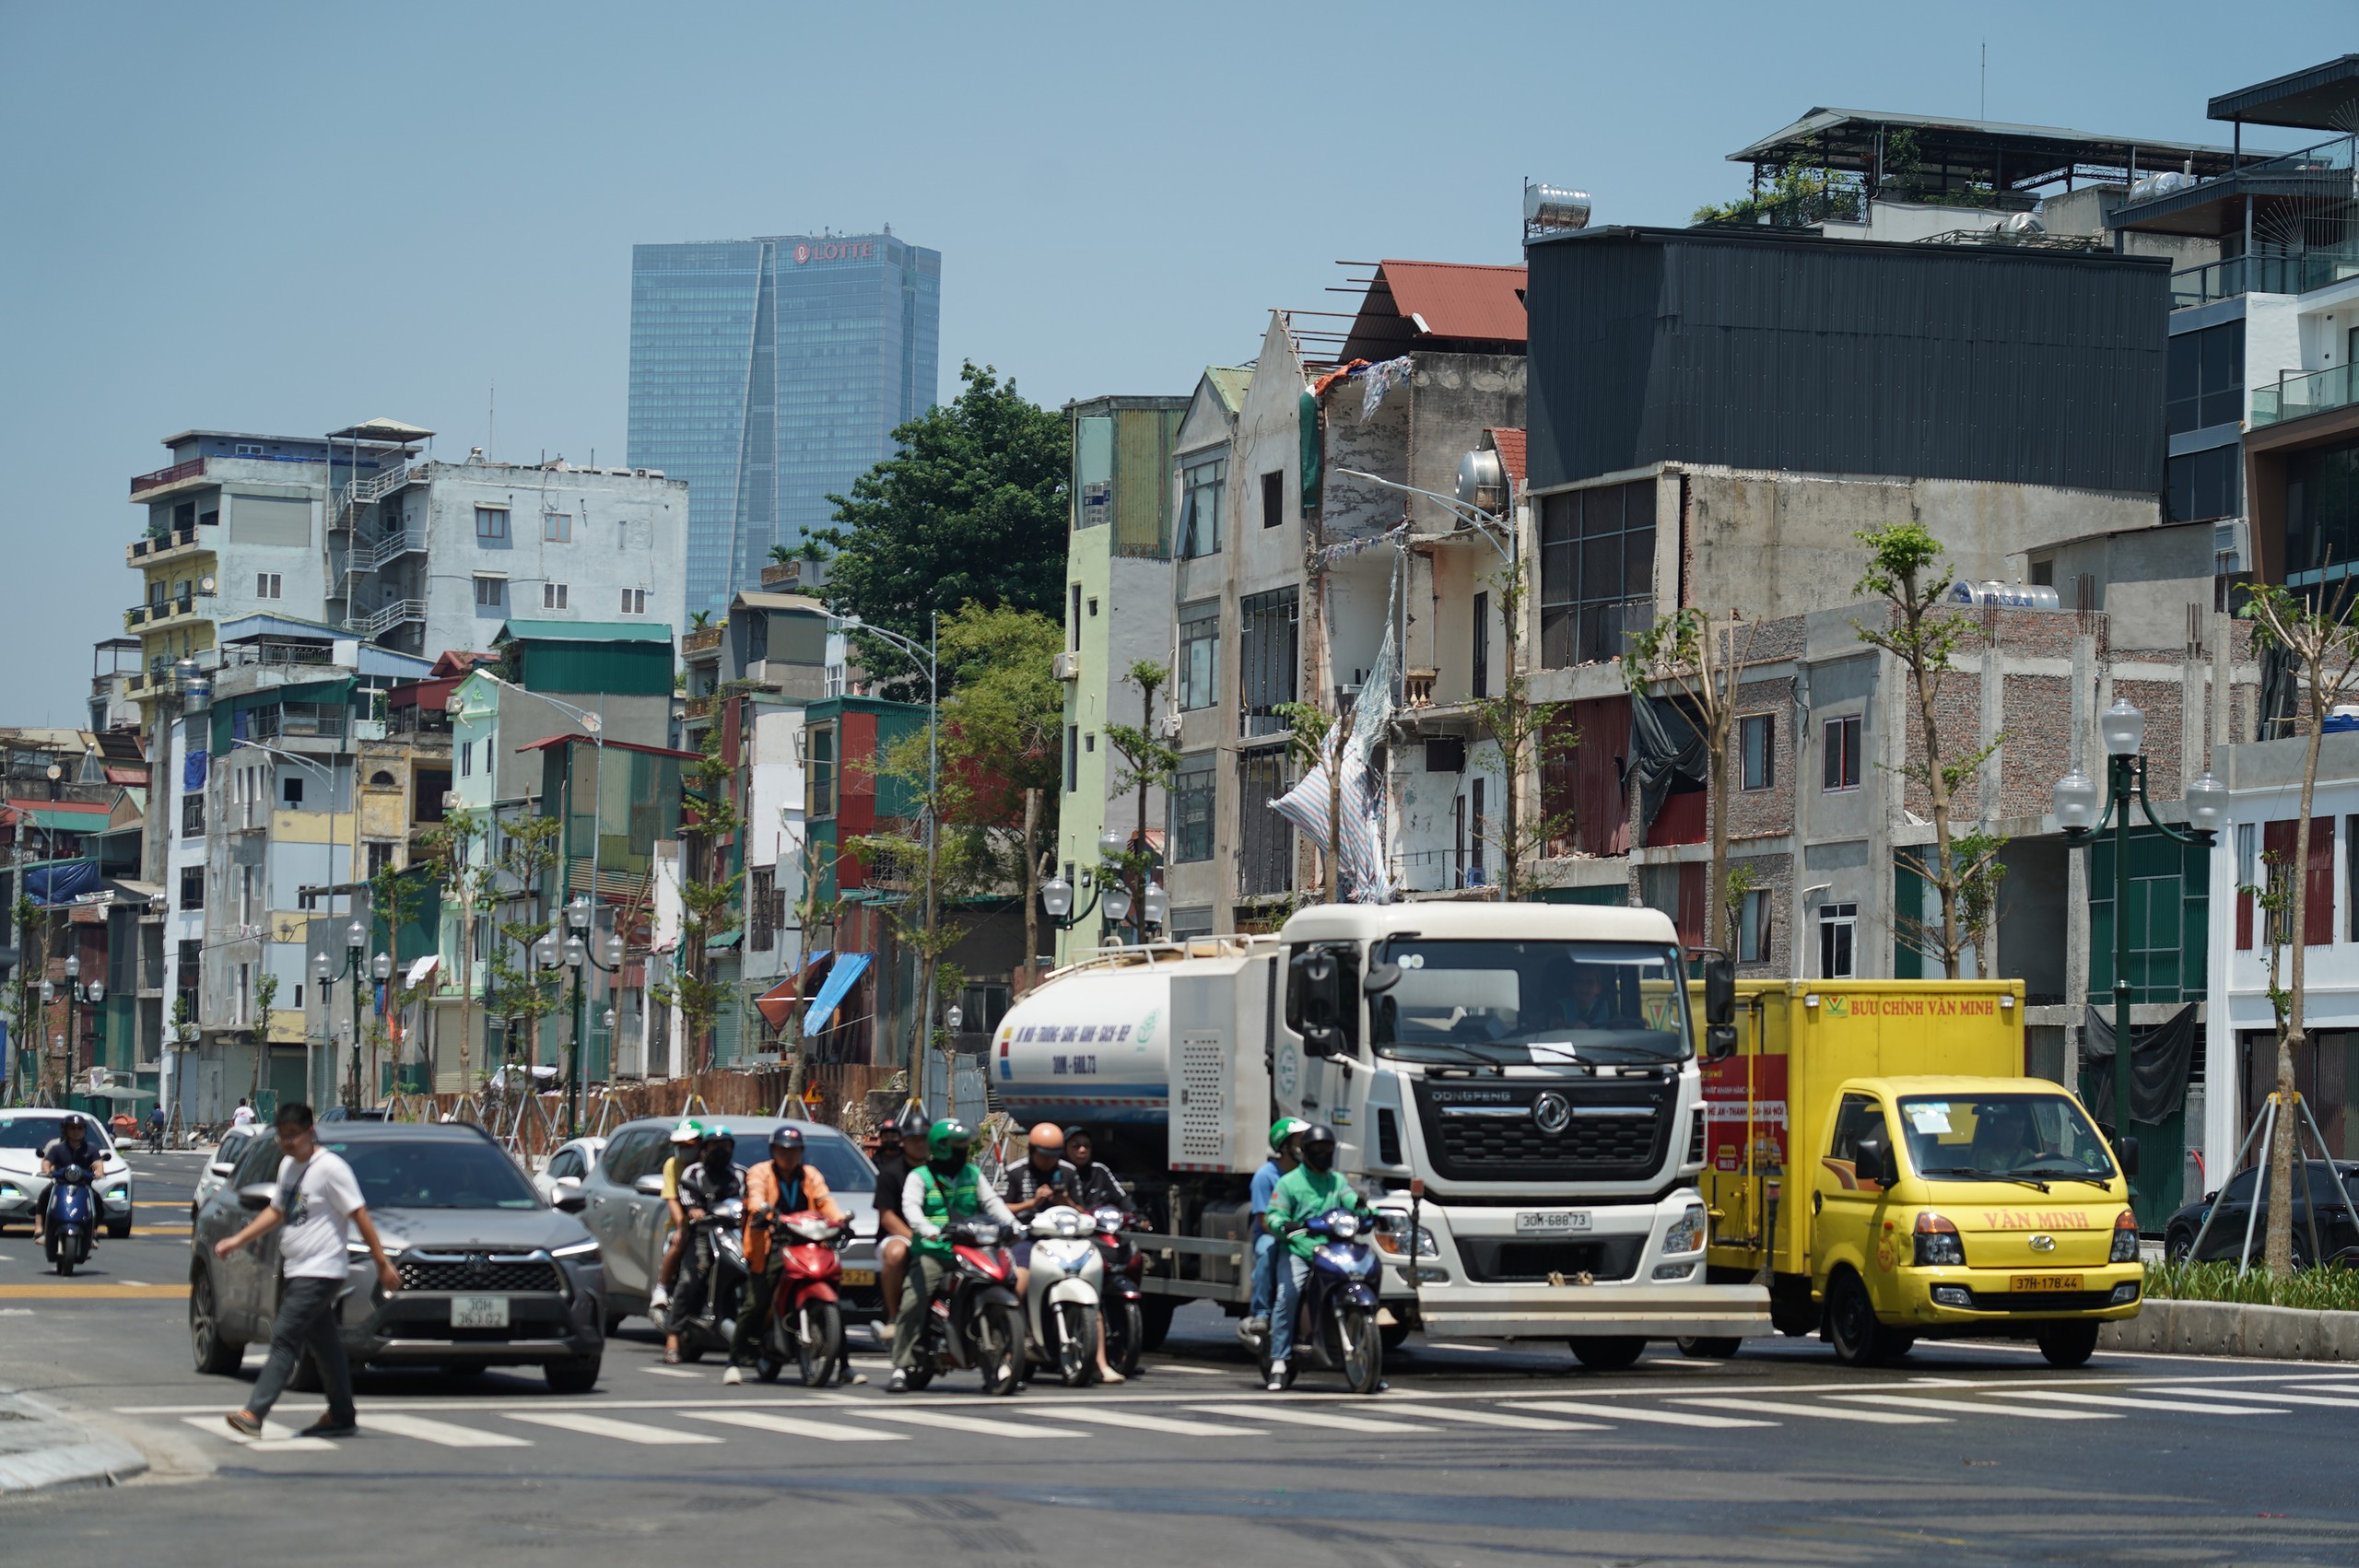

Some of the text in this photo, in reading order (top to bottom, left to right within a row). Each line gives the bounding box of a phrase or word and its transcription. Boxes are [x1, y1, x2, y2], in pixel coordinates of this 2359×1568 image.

[813, 242, 875, 260] LOTTE
[1851, 995, 1993, 1016] BƯU CHÍNH VĂN MINH
[1431, 1091, 1511, 1102] DONGFENG
[1983, 1208, 2090, 1229] VĂN MINH
[2016, 1277, 2078, 1290] 37H-178.44
